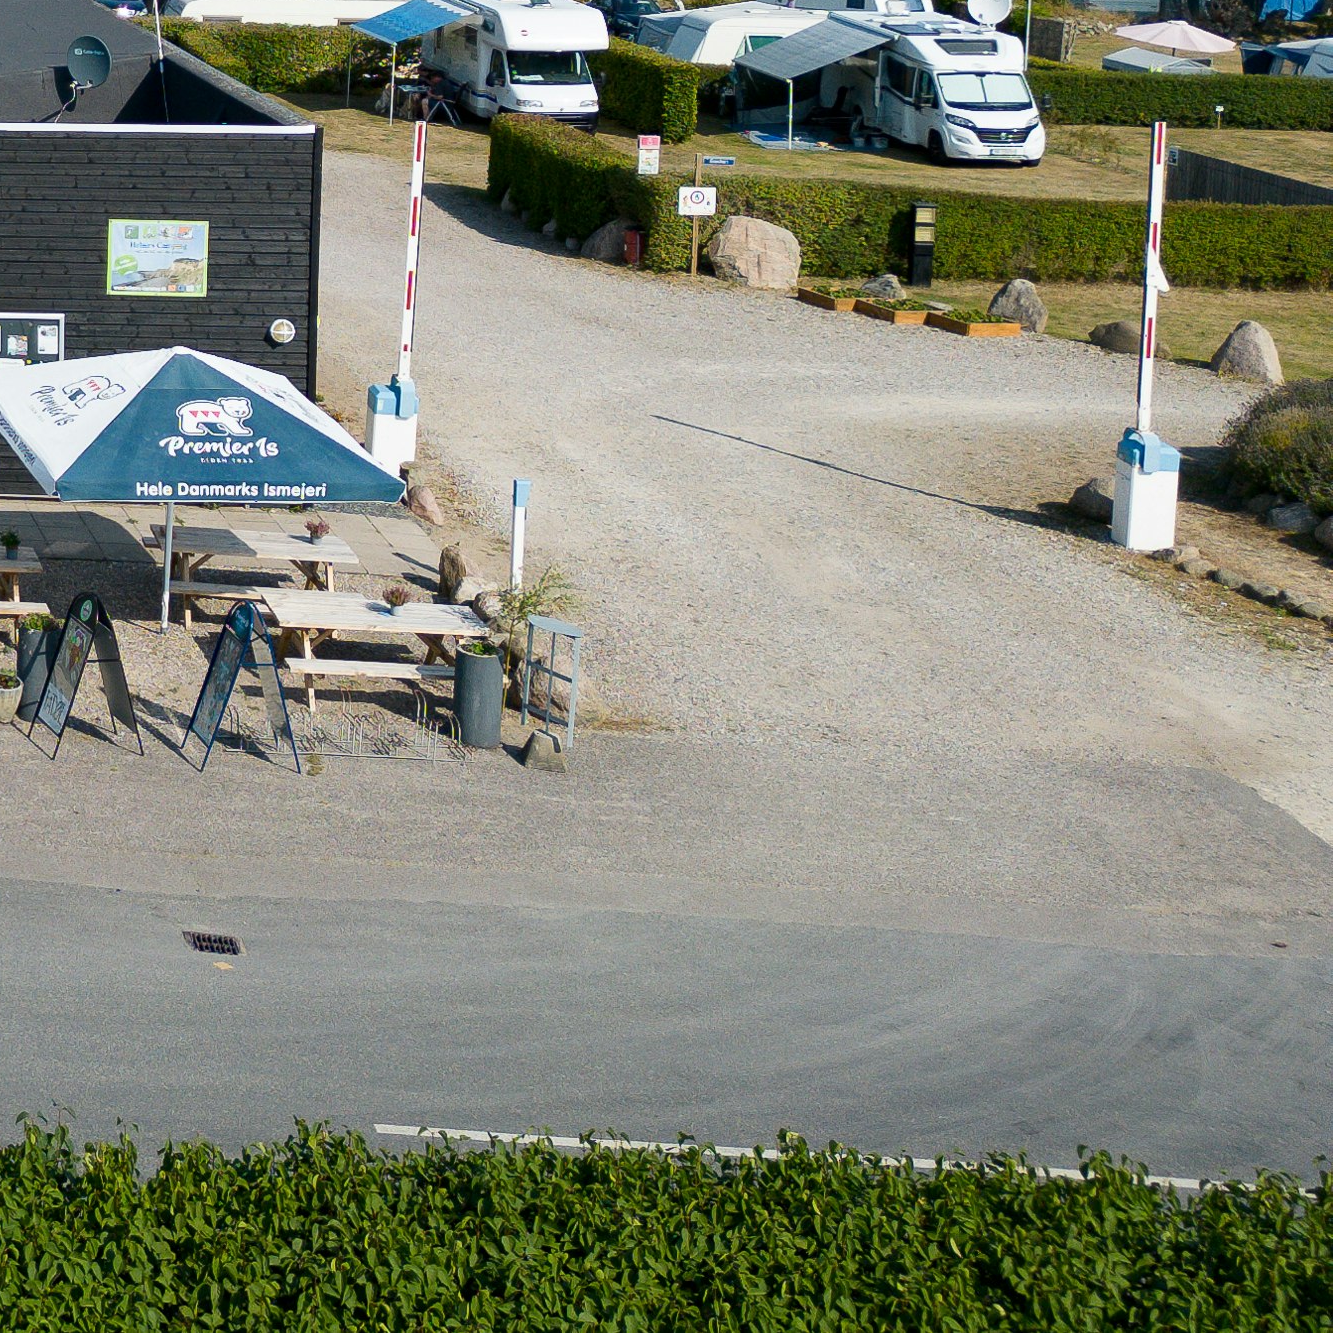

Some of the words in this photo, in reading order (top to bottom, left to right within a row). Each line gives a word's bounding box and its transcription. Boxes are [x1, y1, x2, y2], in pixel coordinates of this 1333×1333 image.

[159, 436, 254, 457] Premier
[255, 436, 279, 457] Is
[136, 481, 173, 496] Hele
[177, 481, 259, 497] Danmarks
[263, 482, 327, 500] Ismejeri
